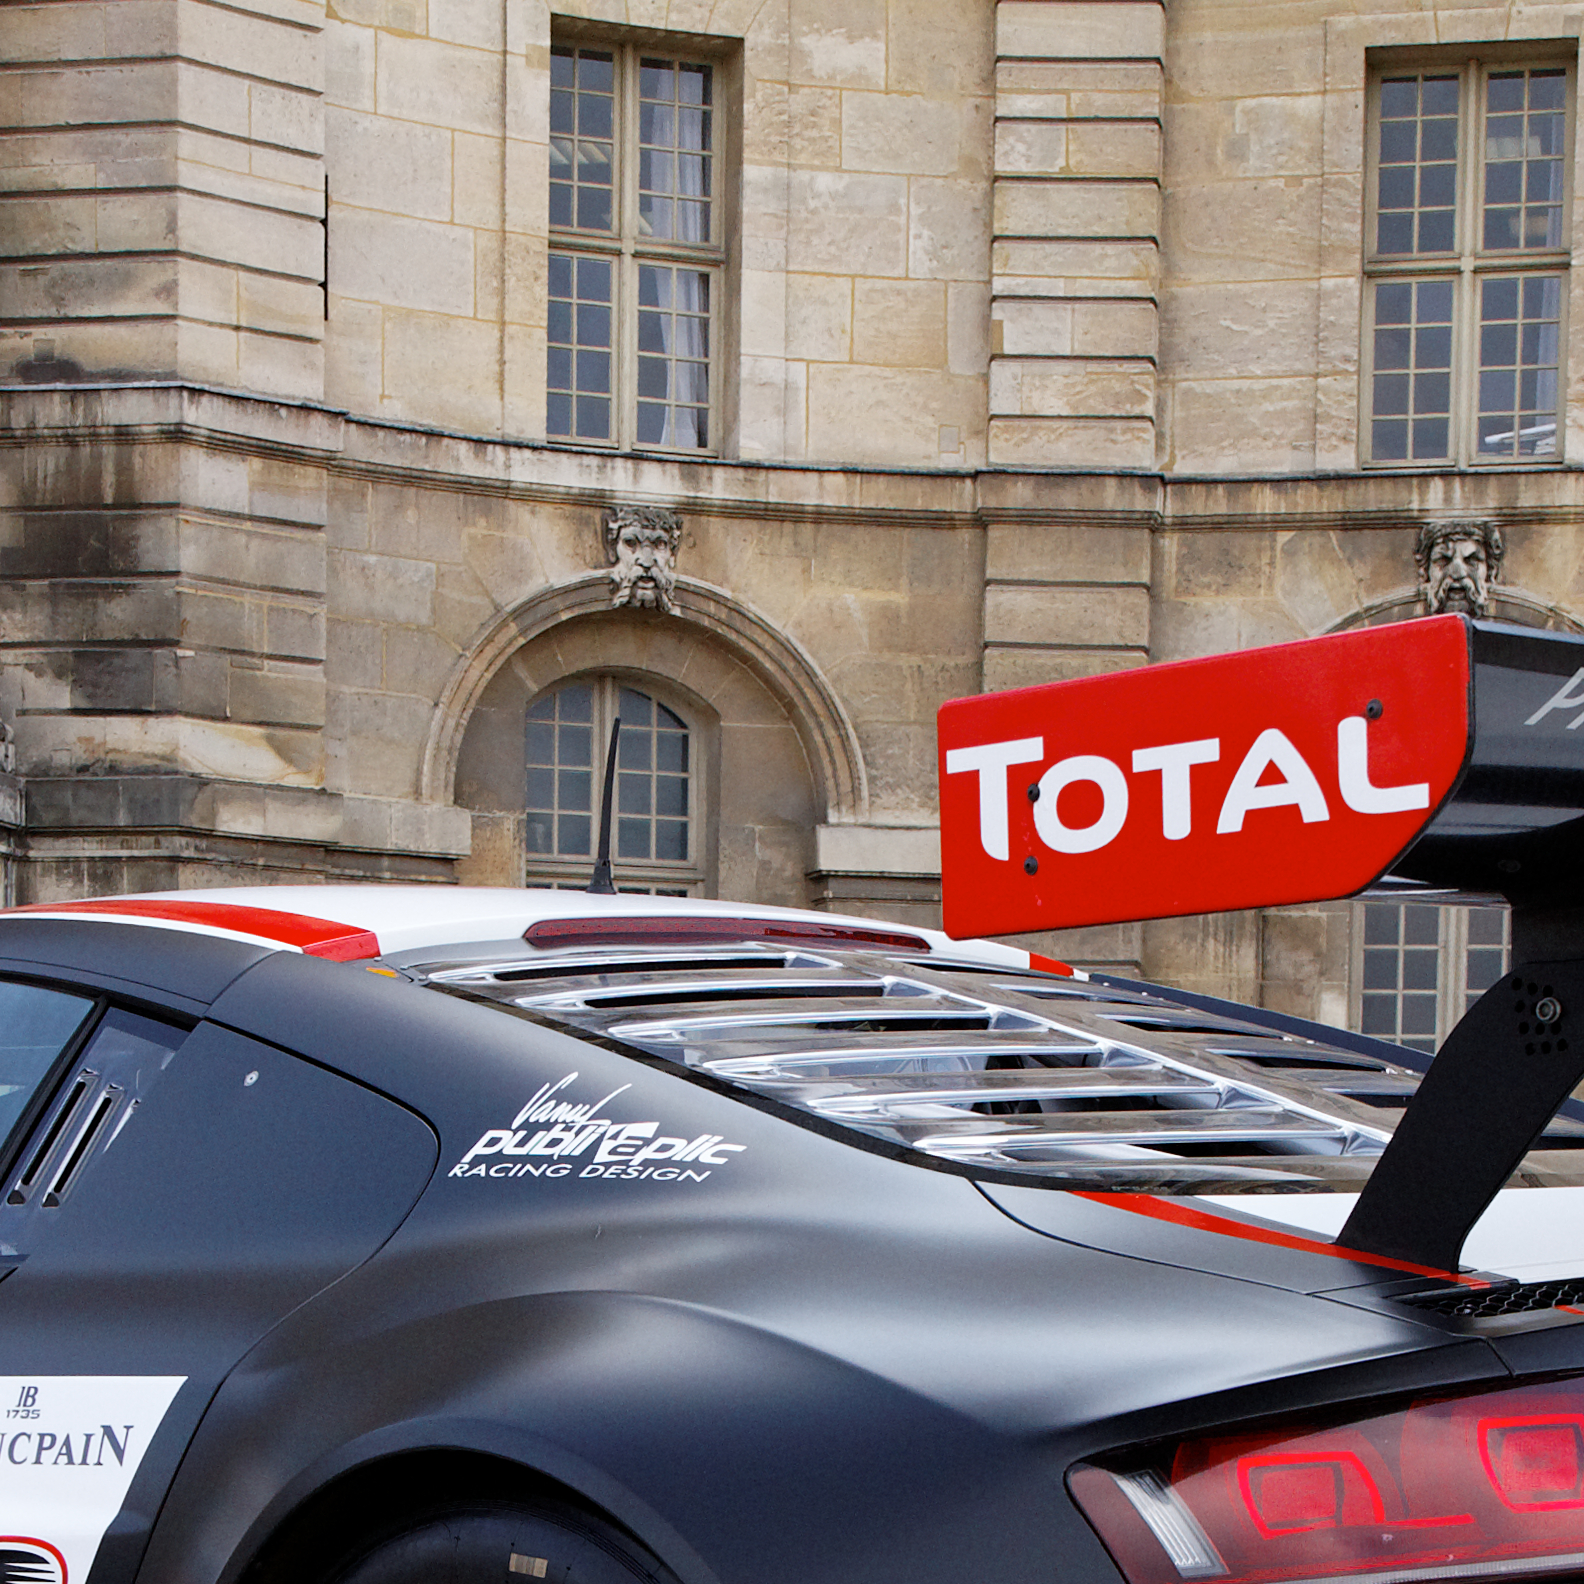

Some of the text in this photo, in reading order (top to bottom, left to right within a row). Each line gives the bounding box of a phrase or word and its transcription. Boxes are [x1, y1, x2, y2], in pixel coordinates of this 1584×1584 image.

[946, 715, 1430, 861] TOTAL
[447, 1163, 712, 1183] RACING DESIGN
[6, 1409, 41, 1420] 1735
